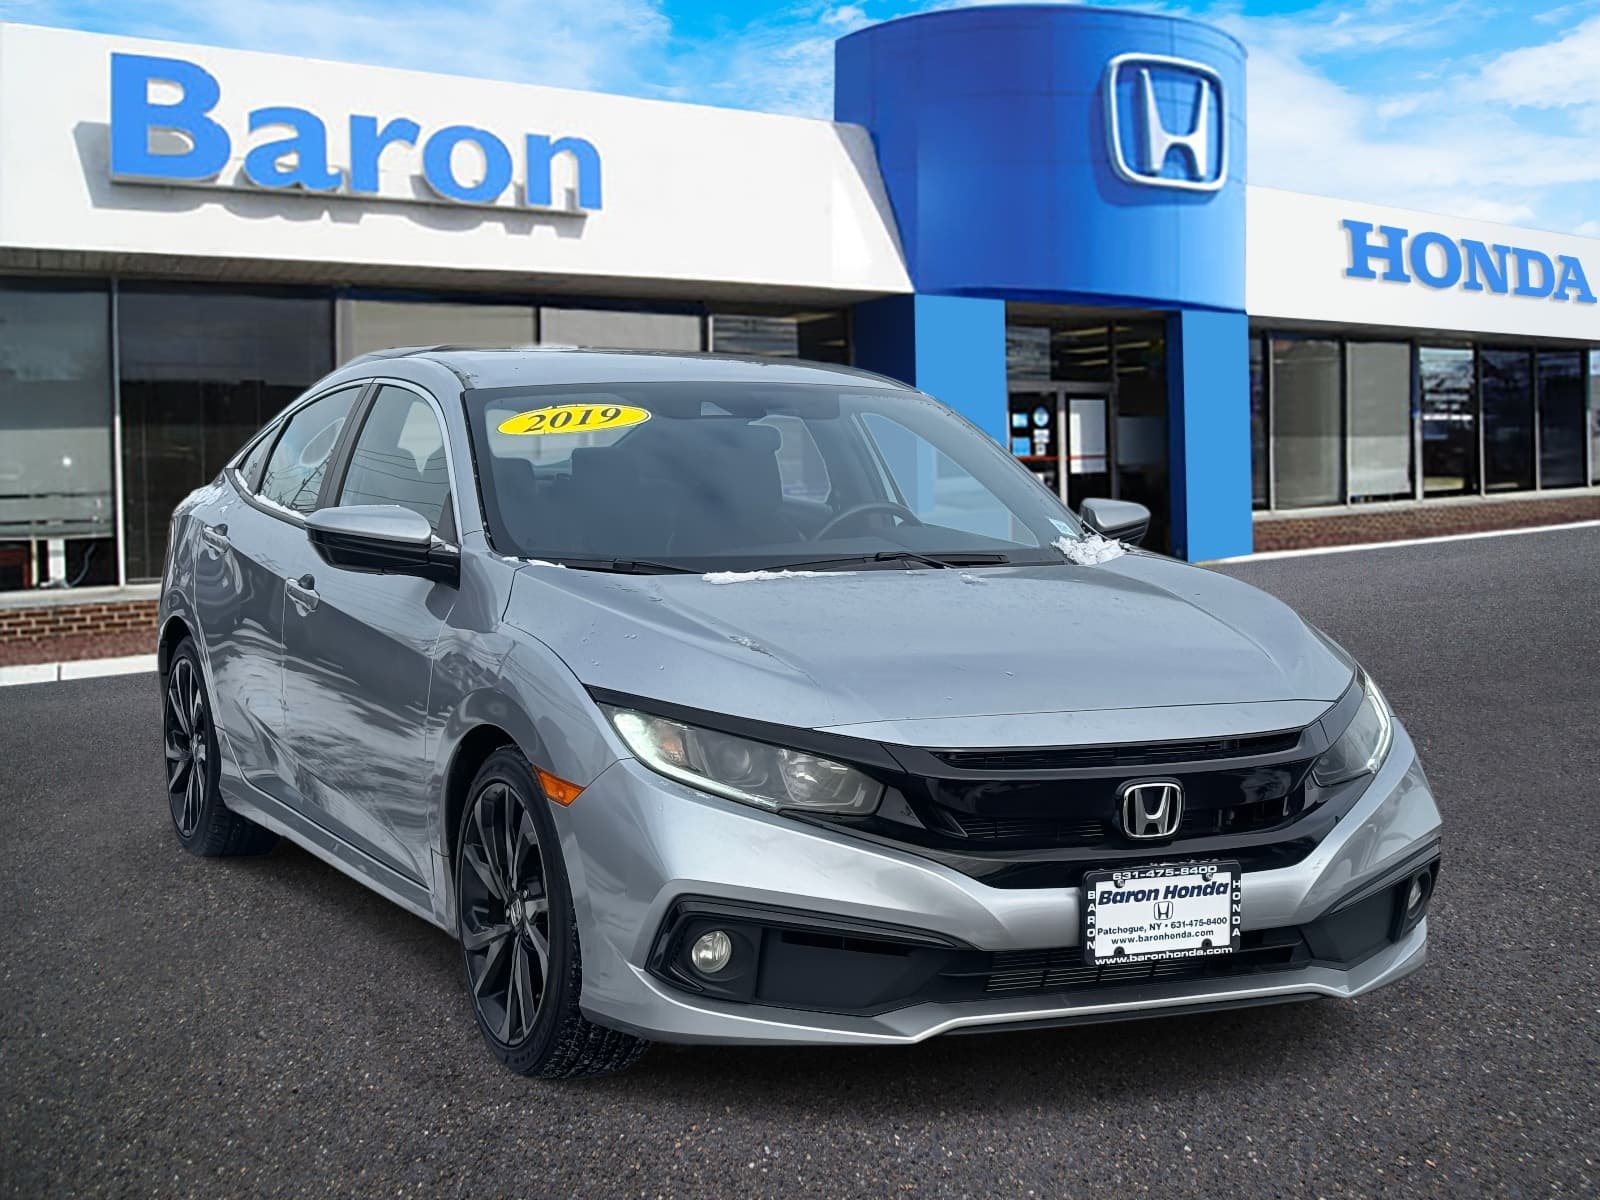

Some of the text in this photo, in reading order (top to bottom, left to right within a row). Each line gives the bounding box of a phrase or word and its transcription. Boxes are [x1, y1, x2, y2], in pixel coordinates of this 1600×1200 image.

[110, 52, 602, 210] Baron
[1342, 218, 1598, 304] HONDA
[523, 407, 622, 433] 2019
[1113, 865, 1217, 880] 631-475-8400
[1097, 881, 1229, 906] Baron Honda
[1087, 891, 1096, 950] BARON
[1232, 880, 1240, 936] HONDA
[1097, 916, 1228, 937] Patchogue, NY 631-475-8400
[1111, 929, 1215, 945] www.baronhonda.com
[1095, 947, 1232, 965] www.baronhonda.com
